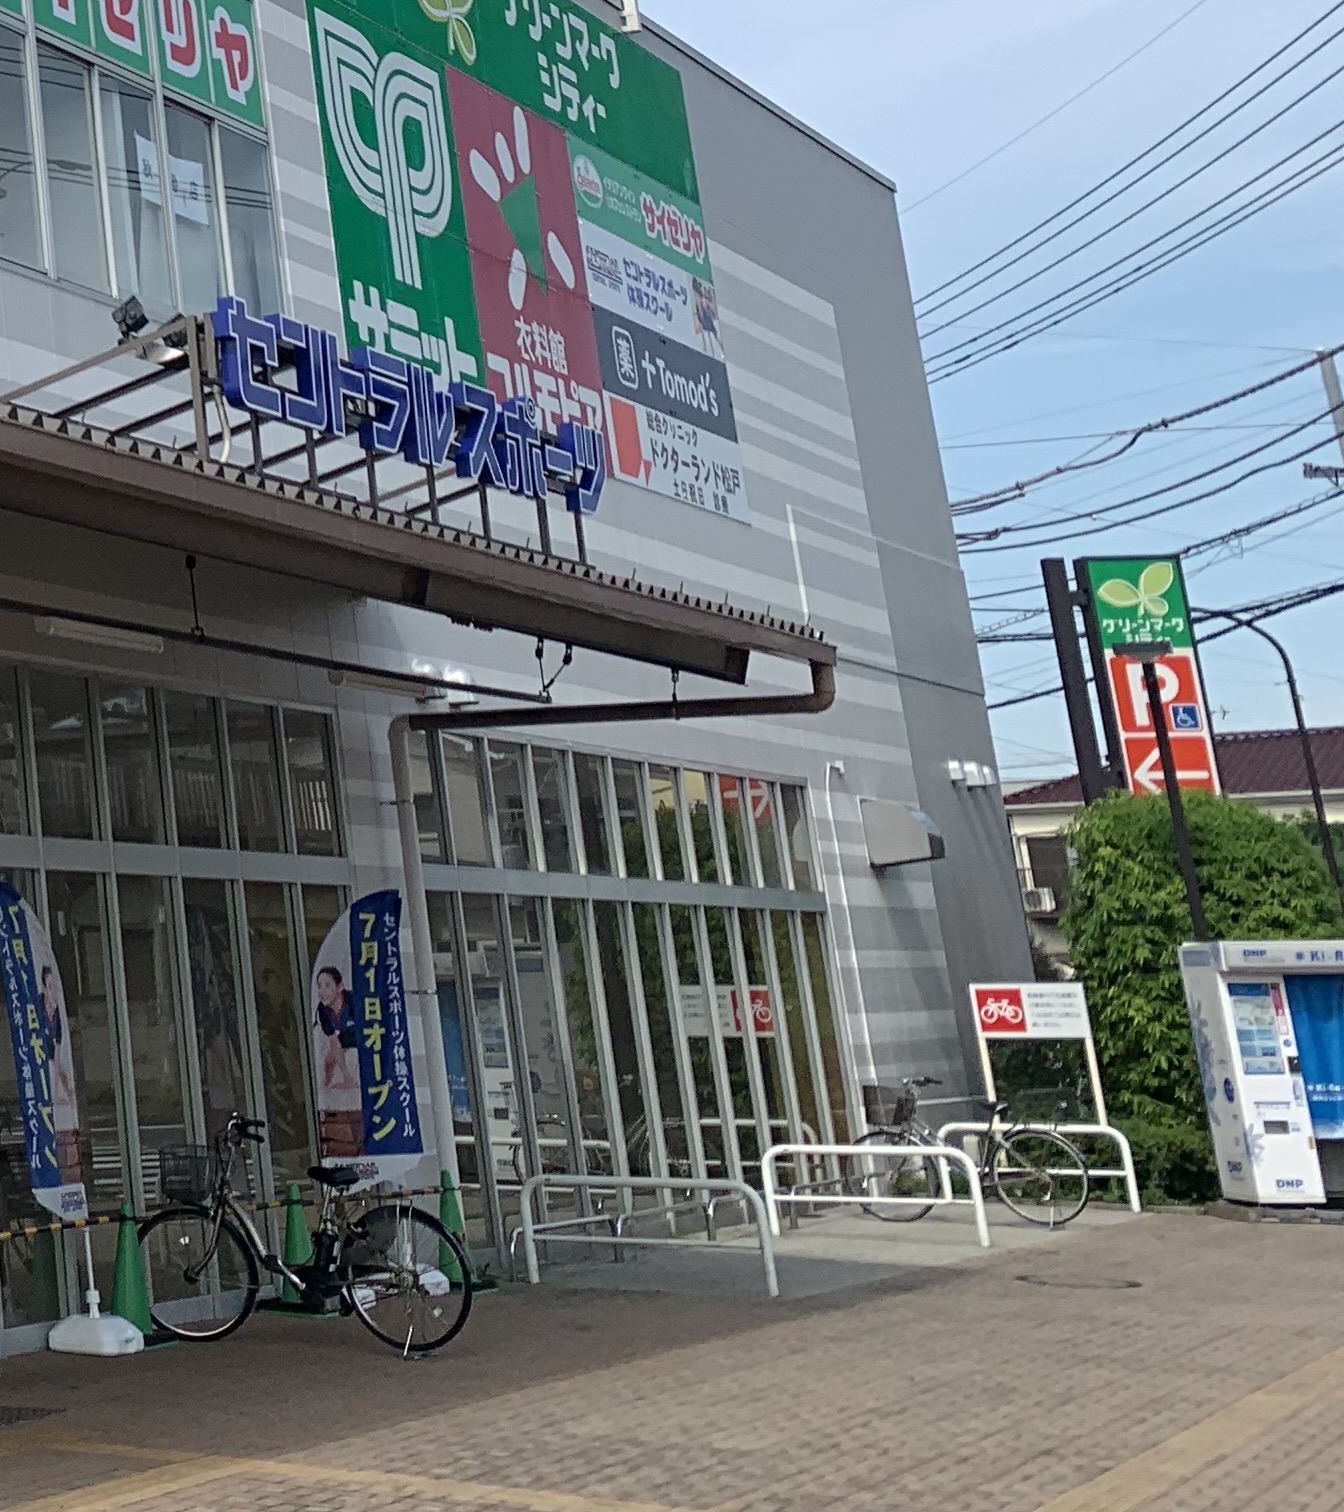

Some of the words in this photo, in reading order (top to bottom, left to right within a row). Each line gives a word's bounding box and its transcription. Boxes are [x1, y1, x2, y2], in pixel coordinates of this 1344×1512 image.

[536, 51, 607, 134] シティー
[640, 191, 705, 265] サイゼリヤ
[514, 315, 569, 376] 衣料館
[615, 336, 636, 380] 薬
[218, 296, 606, 515] セントラルスポーツ
[655, 356, 720, 417] Tomod's
[645, 408, 698, 448] 総合クリニック
[649, 437, 742, 496] ドクターランド松戸
[1102, 617, 1185, 634] グリーンマーク
[1125, 662, 1180, 727] P
[357, 911, 397, 1141] 7月1日オープン
[1275, 1178, 1304, 1189] DNP
